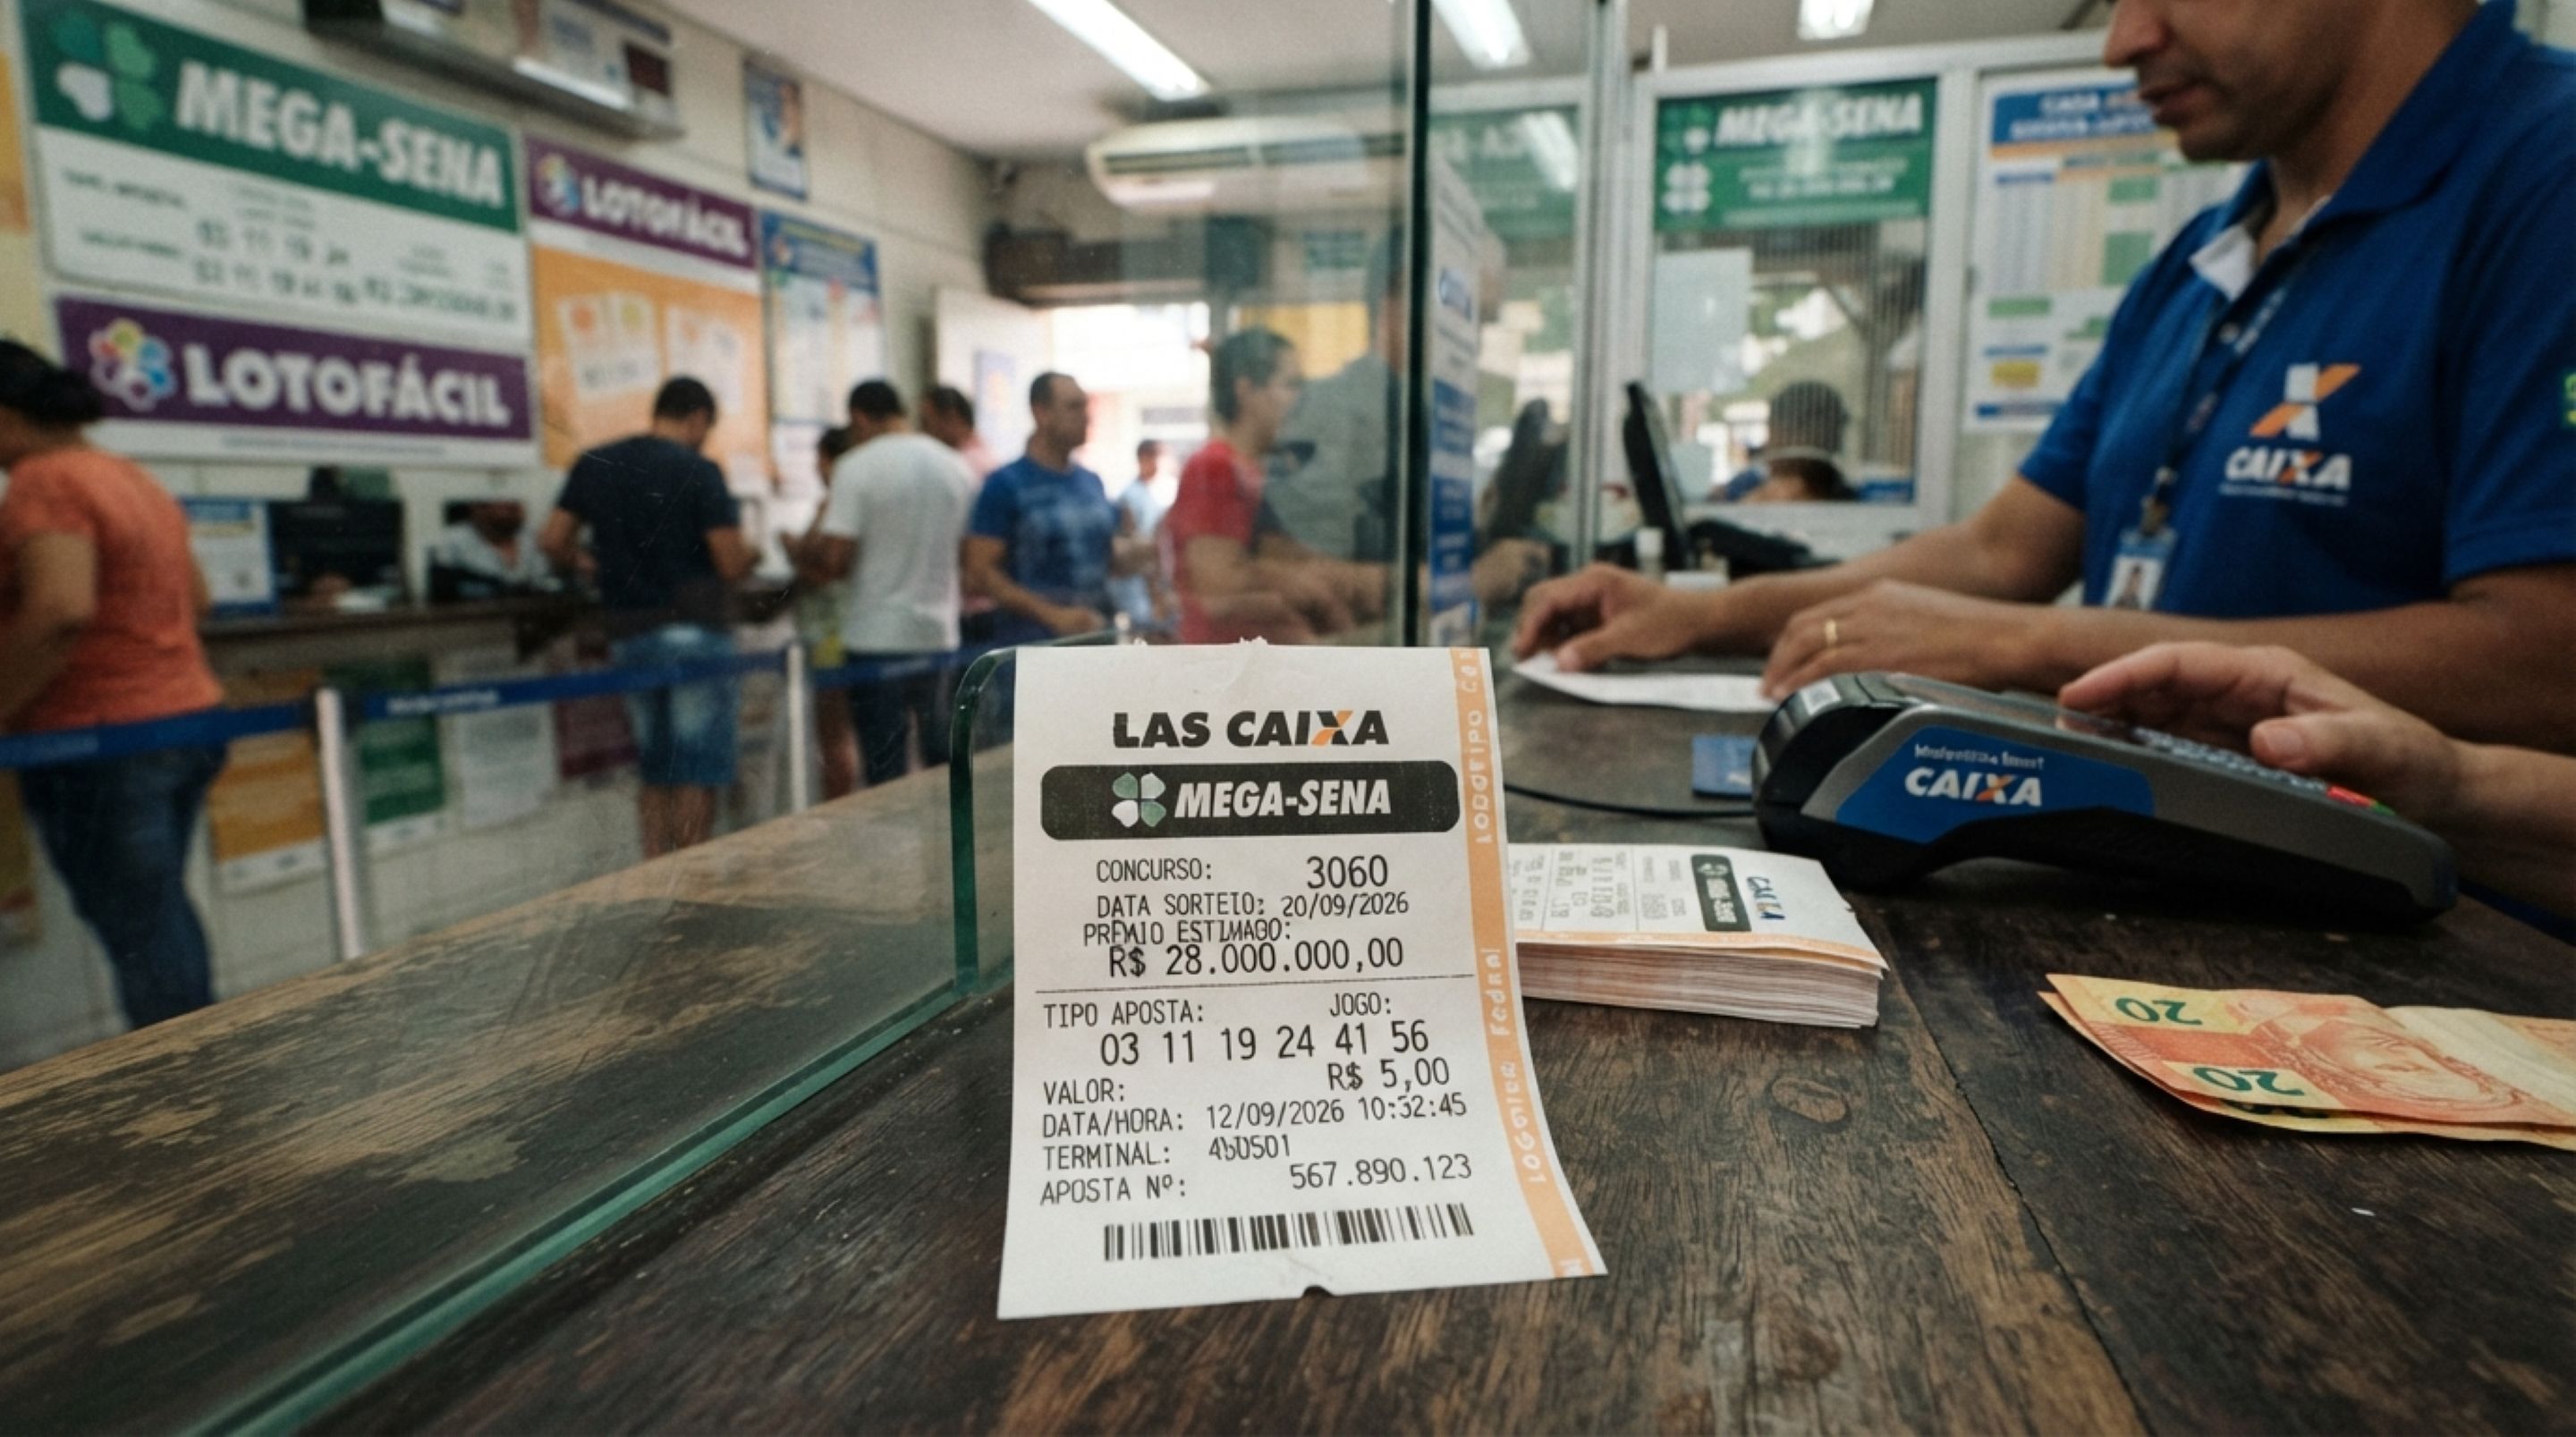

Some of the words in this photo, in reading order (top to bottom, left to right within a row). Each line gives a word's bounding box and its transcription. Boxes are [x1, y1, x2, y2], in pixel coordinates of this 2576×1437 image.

[175, 59, 504, 208] MEGA-SENA
[181, 342, 511, 428] LOTOFÁCIL
[2224, 445, 2351, 491] CAIXA
[1113, 711, 1211, 748] LAS
[1225, 709, 1390, 748] CAIXA
[1174, 779, 1392, 818] MEGA-SENA
[1904, 766, 2042, 807] CAIXA
[1096, 858, 1212, 883] CONCURSO:
[1306, 854, 1388, 889] 3060
[1097, 895, 1151, 918] DATA
[1282, 892, 1409, 920] 20/09/2026
[1109, 944, 1147, 977] R$
[1165, 937, 1404, 976] 28.000.000,00
[1044, 1002, 1098, 1028] TIPO
[1112, 1000, 1204, 1026] APOSTA:
[1329, 992, 1392, 1017] JOGO:
[2114, 997, 2203, 1026] 20
[1100, 1032, 1140, 1066] 03
[1163, 1029, 1194, 1063] 11
[1220, 1027, 1257, 1061] 19
[1276, 1024, 1315, 1059] 24
[1335, 1022, 1368, 1055] 41
[1391, 1019, 1429, 1053] 56
[1043, 1078, 1125, 1105] VALOR:
[1327, 1061, 1363, 1091] R$
[1379, 1056, 1450, 1093] 5,00
[2192, 1067, 2305, 1096] 20
[1042, 1108, 1183, 1138] DATA/HORA:
[1207, 1099, 1344, 1129] 12/09/2026
[1043, 1141, 1170, 1171] TERMINAL:
[1040, 1177, 1131, 1205] APOSTA
[1290, 1154, 1472, 1190] 567.890.123
